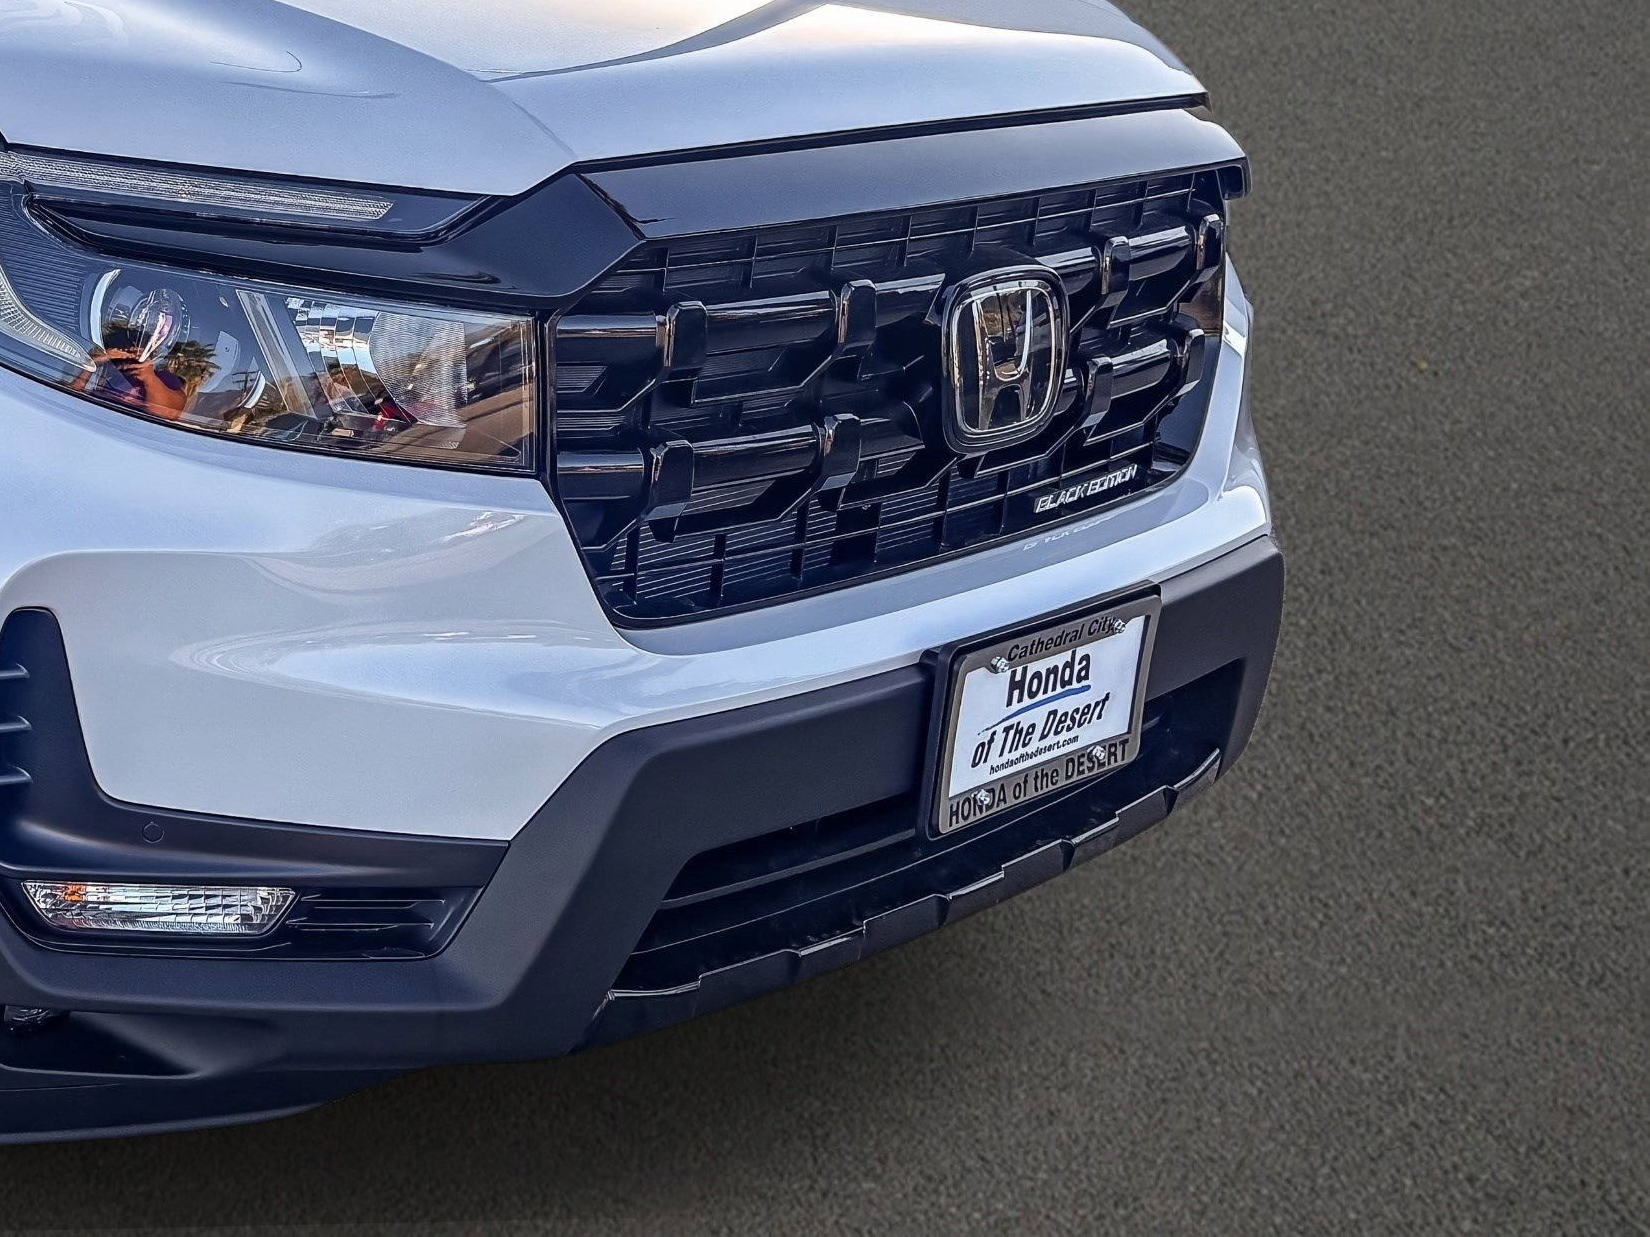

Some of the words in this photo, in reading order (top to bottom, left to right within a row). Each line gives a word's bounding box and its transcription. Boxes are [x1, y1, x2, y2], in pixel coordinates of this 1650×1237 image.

[1034, 482, 1088, 513] BLACK
[1087, 463, 1138, 496] EDITION
[1007, 623, 1086, 662] Cathedral
[1087, 616, 1118, 637] City
[1006, 649, 1092, 707] Honda
[970, 729, 998, 768] of
[998, 721, 1037, 758] The
[1038, 692, 1111, 743] Desert
[988, 734, 1080, 775] hondaofthedesert.com
[1012, 774, 1031, 800] of
[1033, 768, 1059, 789] the
